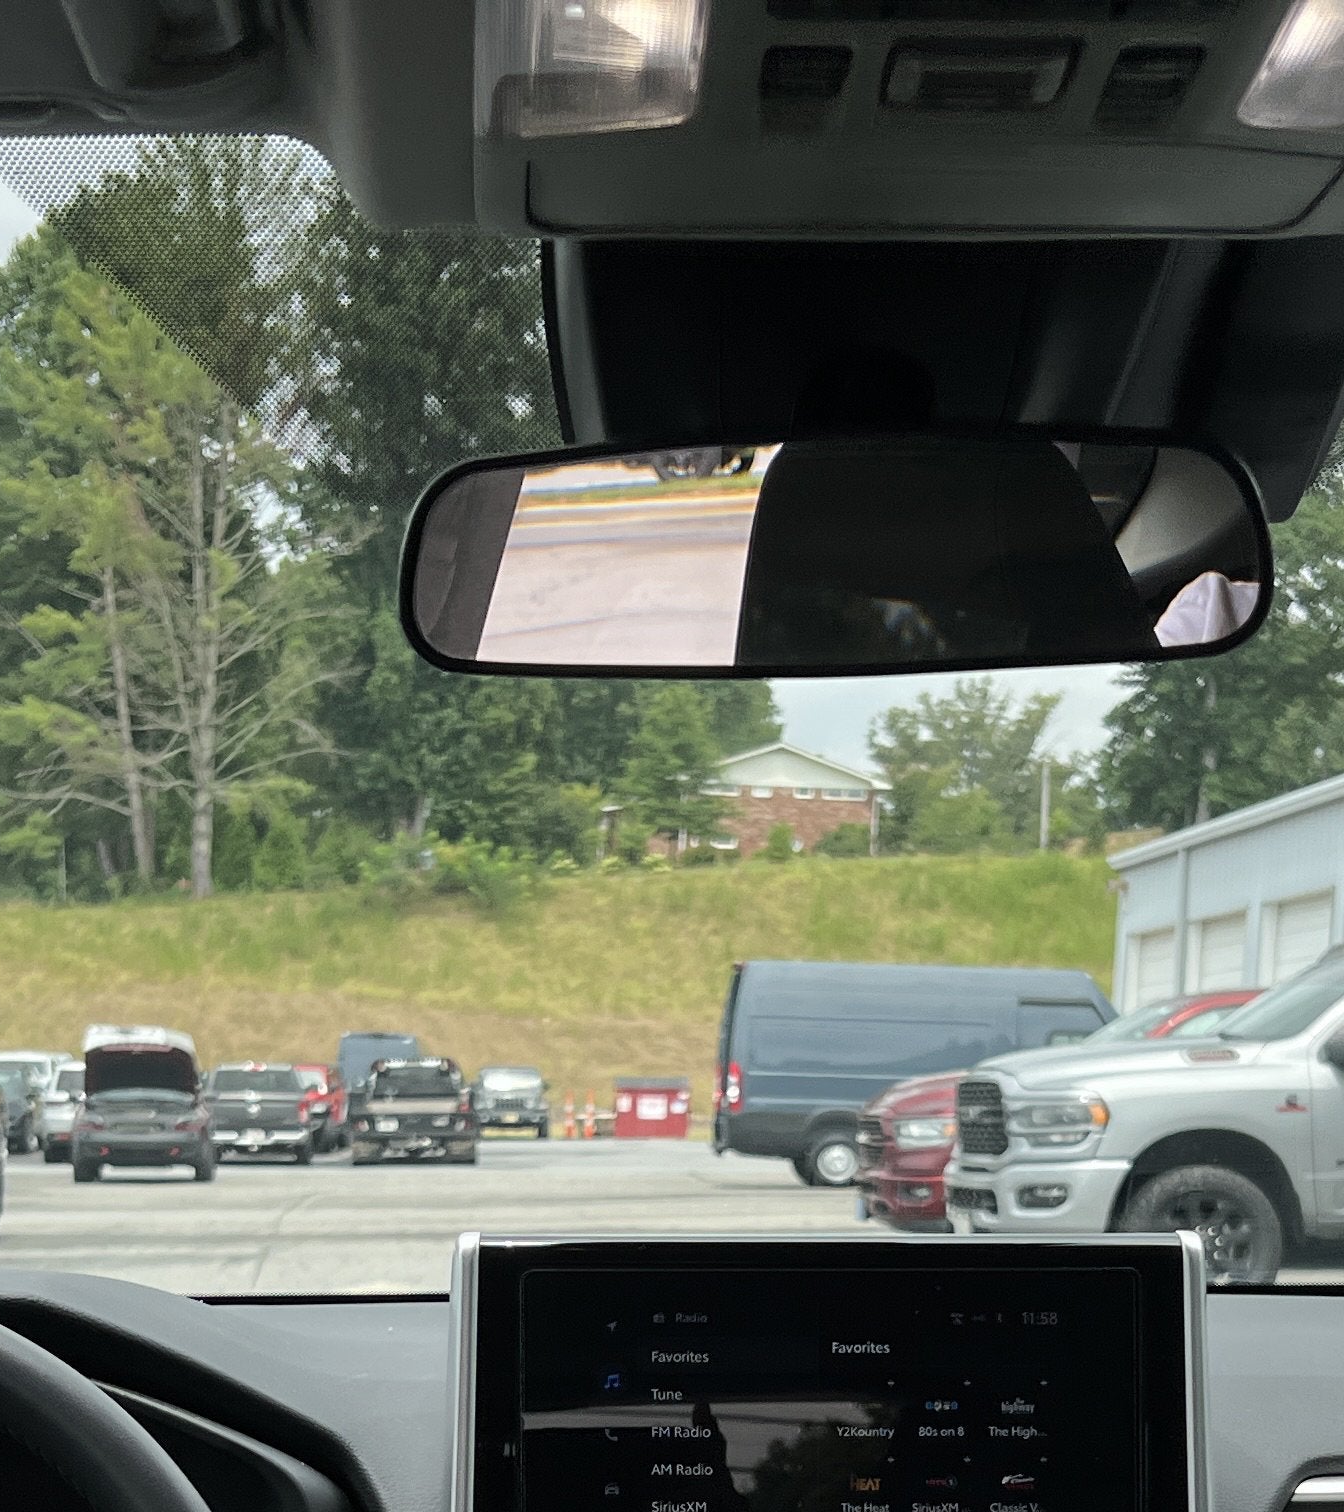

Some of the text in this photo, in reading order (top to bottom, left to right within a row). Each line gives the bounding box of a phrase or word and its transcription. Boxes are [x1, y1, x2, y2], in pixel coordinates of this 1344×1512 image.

[674, 1311, 709, 1324] Radio
[831, 1340, 891, 1355] Favorites
[650, 1350, 710, 1364] Favorites
[650, 1387, 683, 1401] Tune
[650, 1425, 712, 1439] FM Radio
[836, 1425, 896, 1440] Y2Kountry
[918, 1425, 965, 1438] 80s on 8
[988, 1425, 1009, 1438] The
[650, 1463, 714, 1477] AM Radio
